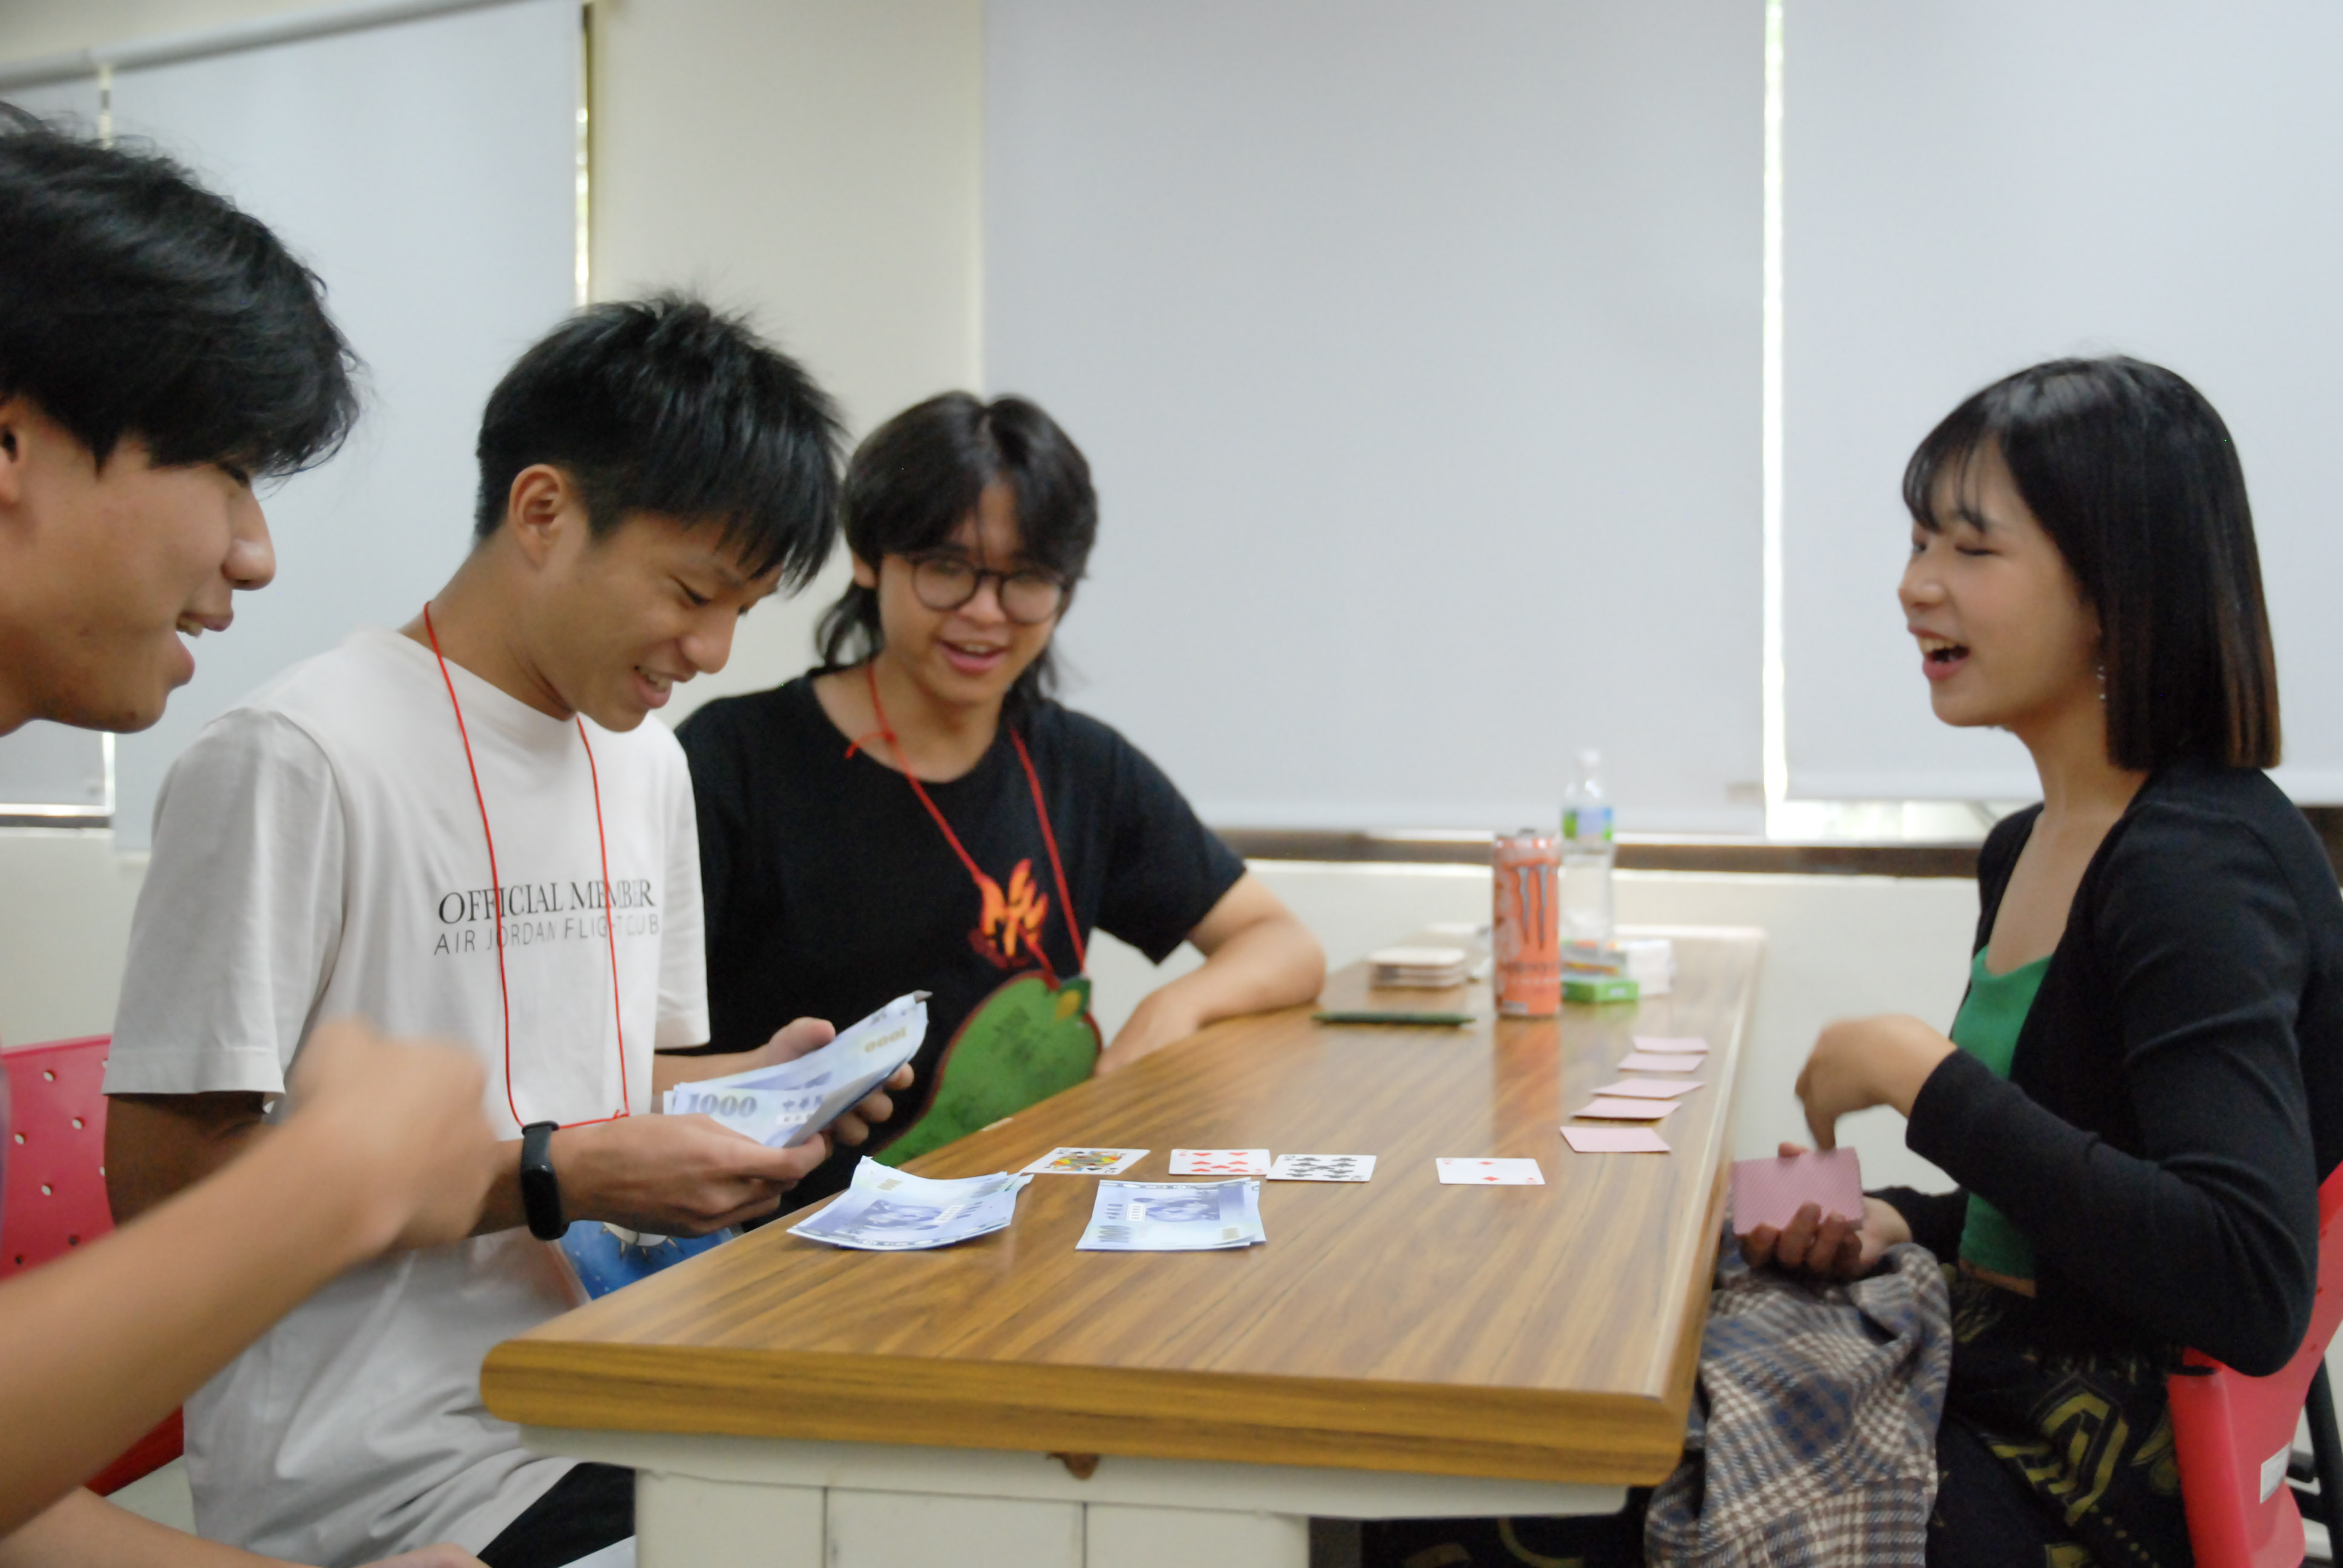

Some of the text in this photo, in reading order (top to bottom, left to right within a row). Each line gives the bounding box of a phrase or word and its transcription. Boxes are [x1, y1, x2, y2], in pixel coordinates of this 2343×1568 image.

[439, 879, 656, 924] OFFICIAL MEMBER
[434, 929, 476, 956] AIR
[487, 921, 555, 950] JORDAN
[689, 1093, 757, 1117] 1000
